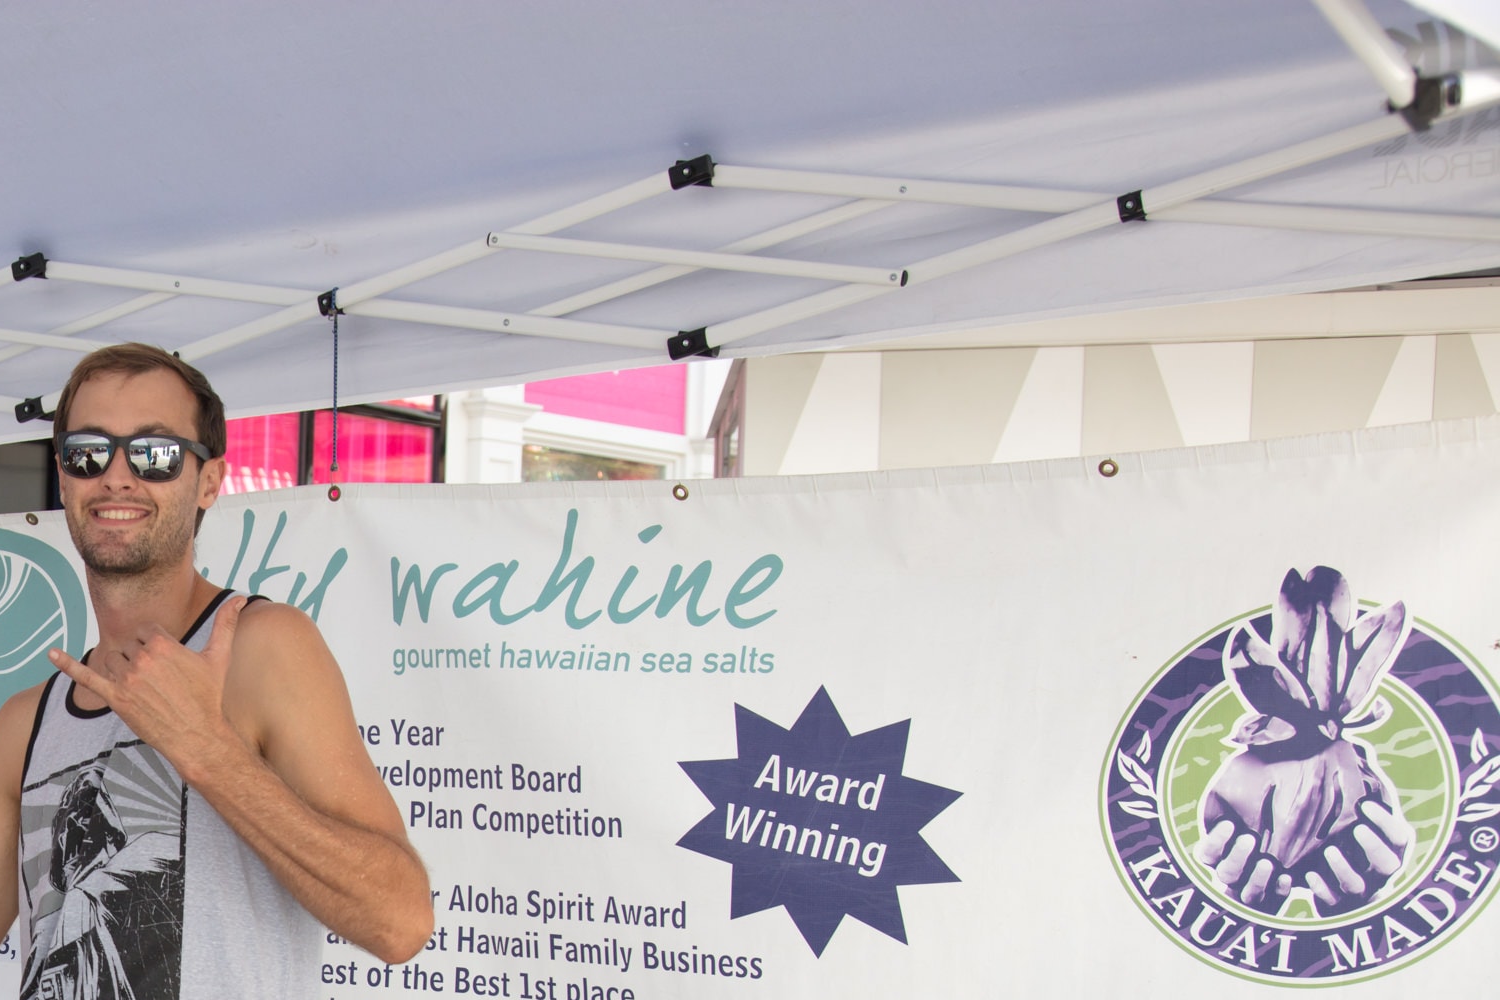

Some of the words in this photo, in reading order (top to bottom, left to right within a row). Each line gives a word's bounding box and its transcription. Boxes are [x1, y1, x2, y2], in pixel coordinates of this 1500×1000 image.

[391, 508, 784, 630] wahine
[393, 643, 490, 676] gourmet
[500, 641, 631, 672] hawaiian
[640, 652, 692, 673] sea
[702, 646, 775, 674] salts
[391, 719, 444, 746] Year
[512, 763, 582, 794] Board
[753, 754, 886, 811] Award
[410, 801, 463, 829] Plan
[472, 803, 623, 839] Competition
[726, 802, 887, 877] Winning
[449, 885, 518, 916] Aloha
[526, 890, 595, 924] Spirit
[604, 896, 687, 929] Award
[458, 926, 539, 959] Hawaii
[549, 933, 632, 973] Family
[643, 941, 763, 979] Business
[367, 963, 393, 988] of
[402, 964, 444, 992] the
[455, 967, 510, 997] Best
[520, 972, 557, 1000] 1st
